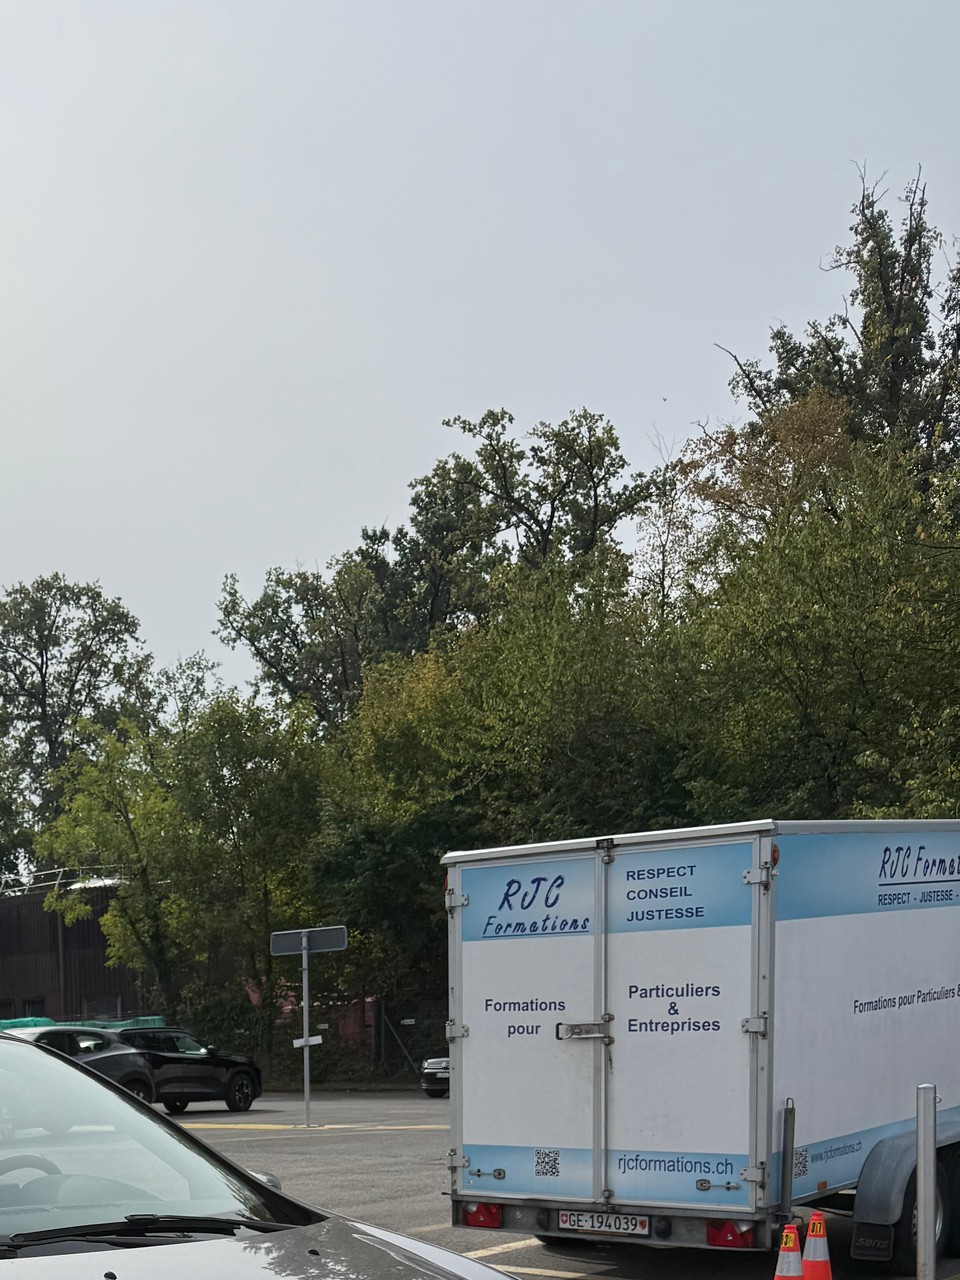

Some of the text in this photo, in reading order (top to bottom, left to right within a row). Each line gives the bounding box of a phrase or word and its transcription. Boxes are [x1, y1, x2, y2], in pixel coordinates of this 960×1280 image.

[879, 845, 911, 879] RJC
[626, 865, 696, 881] RESPECT
[498, 874, 566, 911] RJC
[626, 886, 693, 901] CONSEIL
[878, 892, 911, 906] RESPECT
[920, 889, 953, 903] JUSTESSE
[626, 906, 705, 922] JUSTESSE
[482, 915, 590, 935] Formations
[628, 983, 721, 999] Particuliers
[484, 999, 566, 1012] Formations
[853, 996, 897, 1014] Formations
[898, 994, 916, 1009] pour
[917, 986, 956, 1004] Particuliers
[667, 1002, 679, 1015] &
[507, 1023, 541, 1038] pour
[628, 1018, 721, 1035] Entreprises
[618, 1154, 733, 1175] rjcformations.ch
